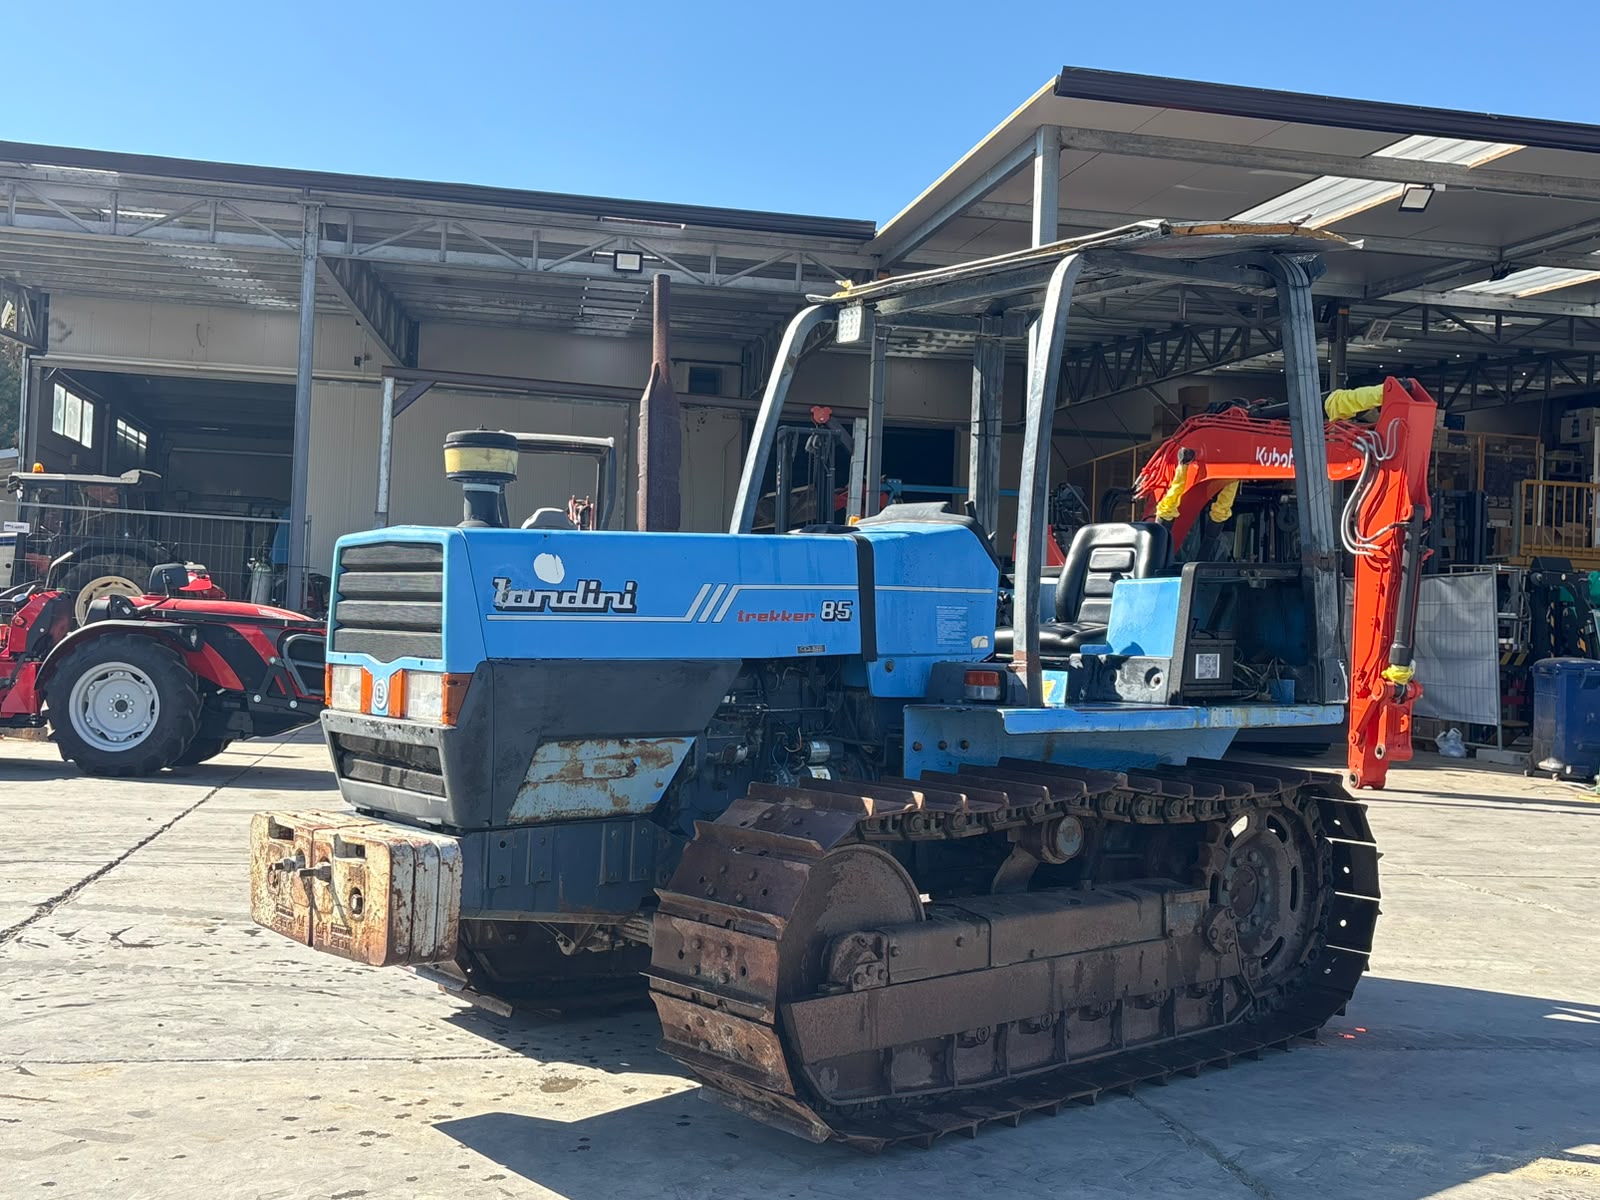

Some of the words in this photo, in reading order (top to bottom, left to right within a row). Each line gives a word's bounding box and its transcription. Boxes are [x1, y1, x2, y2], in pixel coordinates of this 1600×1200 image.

[1255, 446, 1294, 468] Kubot
[737, 610, 815, 622] trekker
[820, 600, 853, 622] 85
